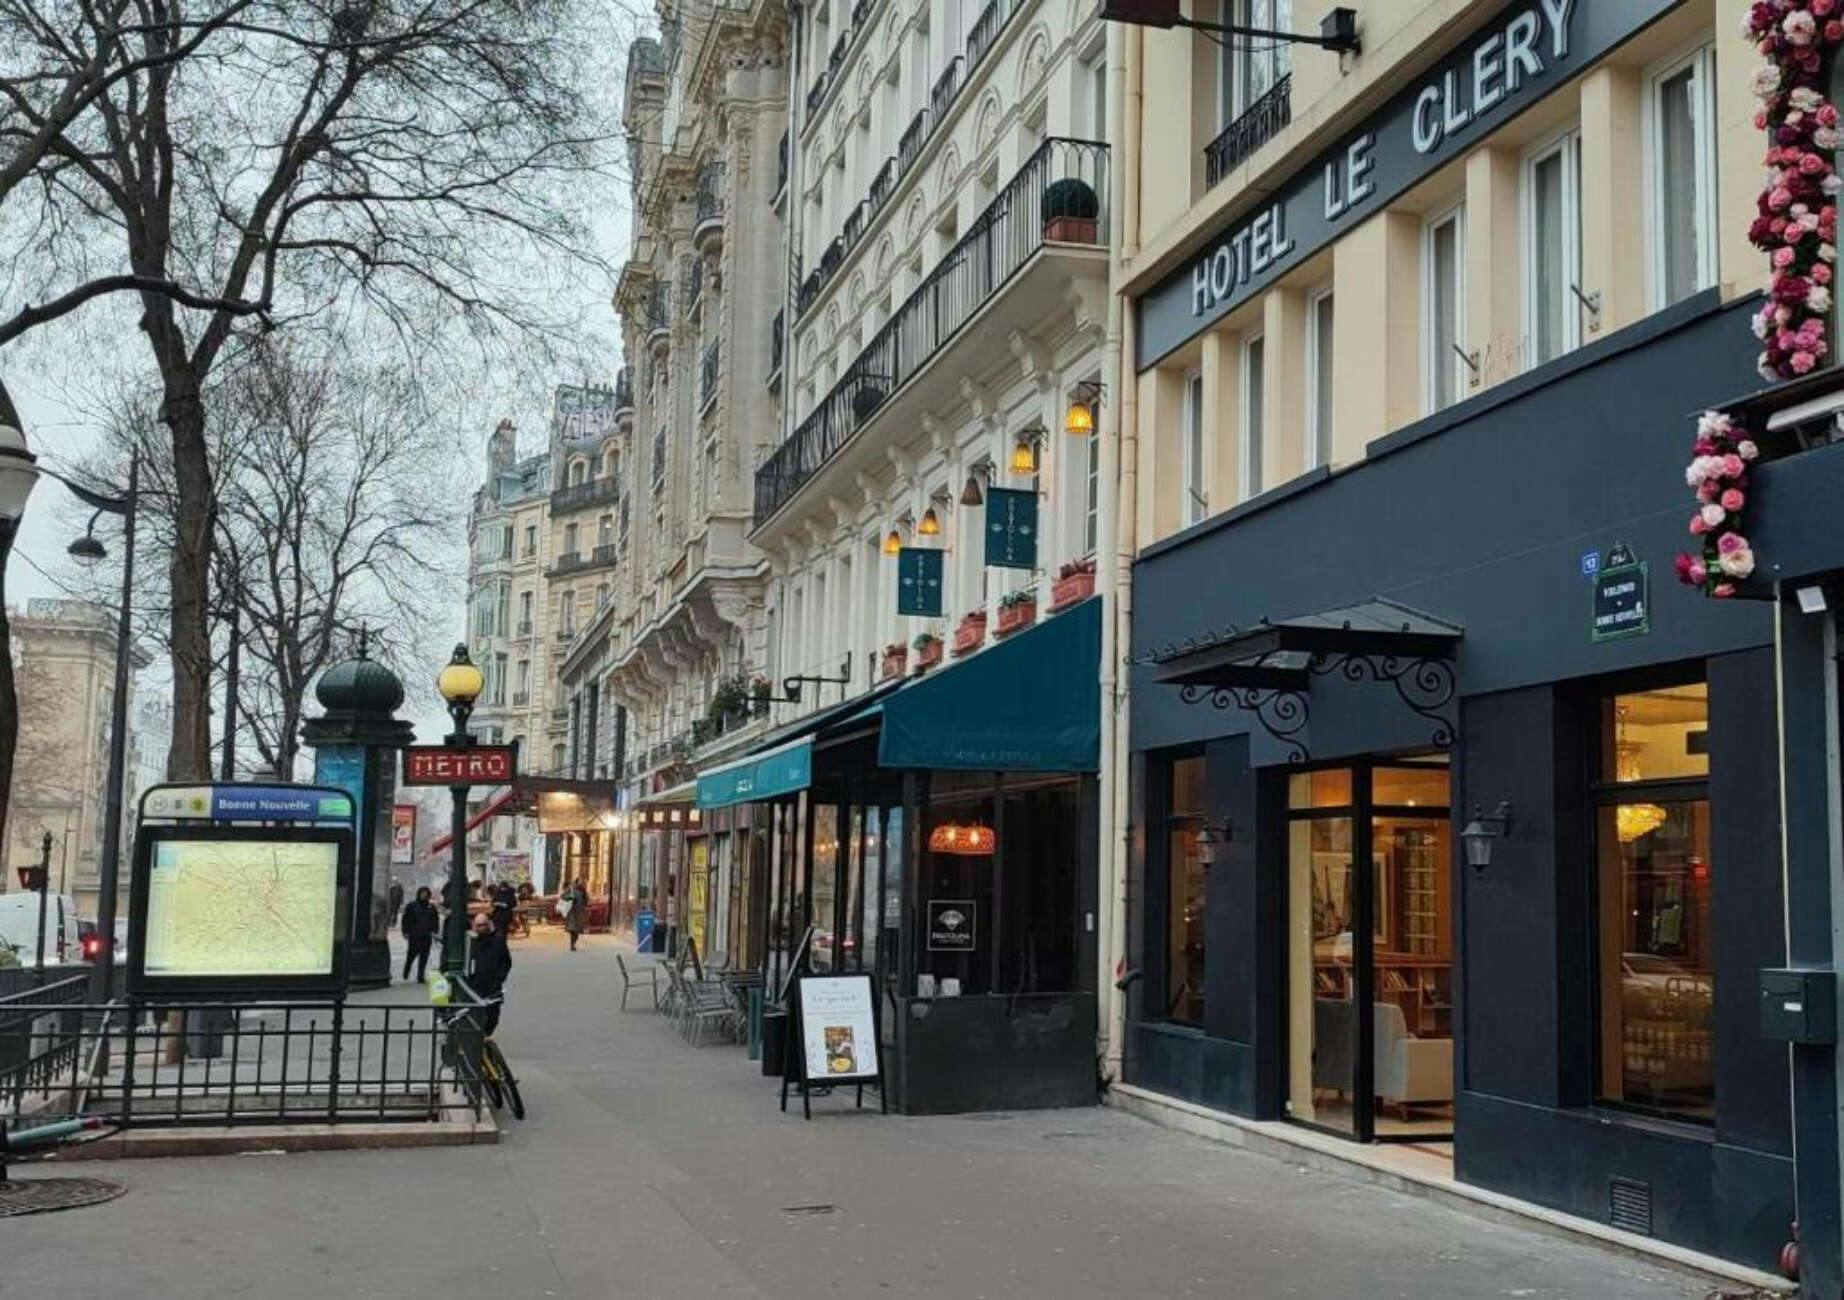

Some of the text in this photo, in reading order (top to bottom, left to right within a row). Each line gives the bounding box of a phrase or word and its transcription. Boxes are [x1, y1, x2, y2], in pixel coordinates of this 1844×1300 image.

[1192, 0, 1573, 315] HOTEL LE CLERY
[414, 755, 505, 776] METRO
[219, 799, 257, 810] Bonne
[259, 799, 311, 811] Nouvelle
